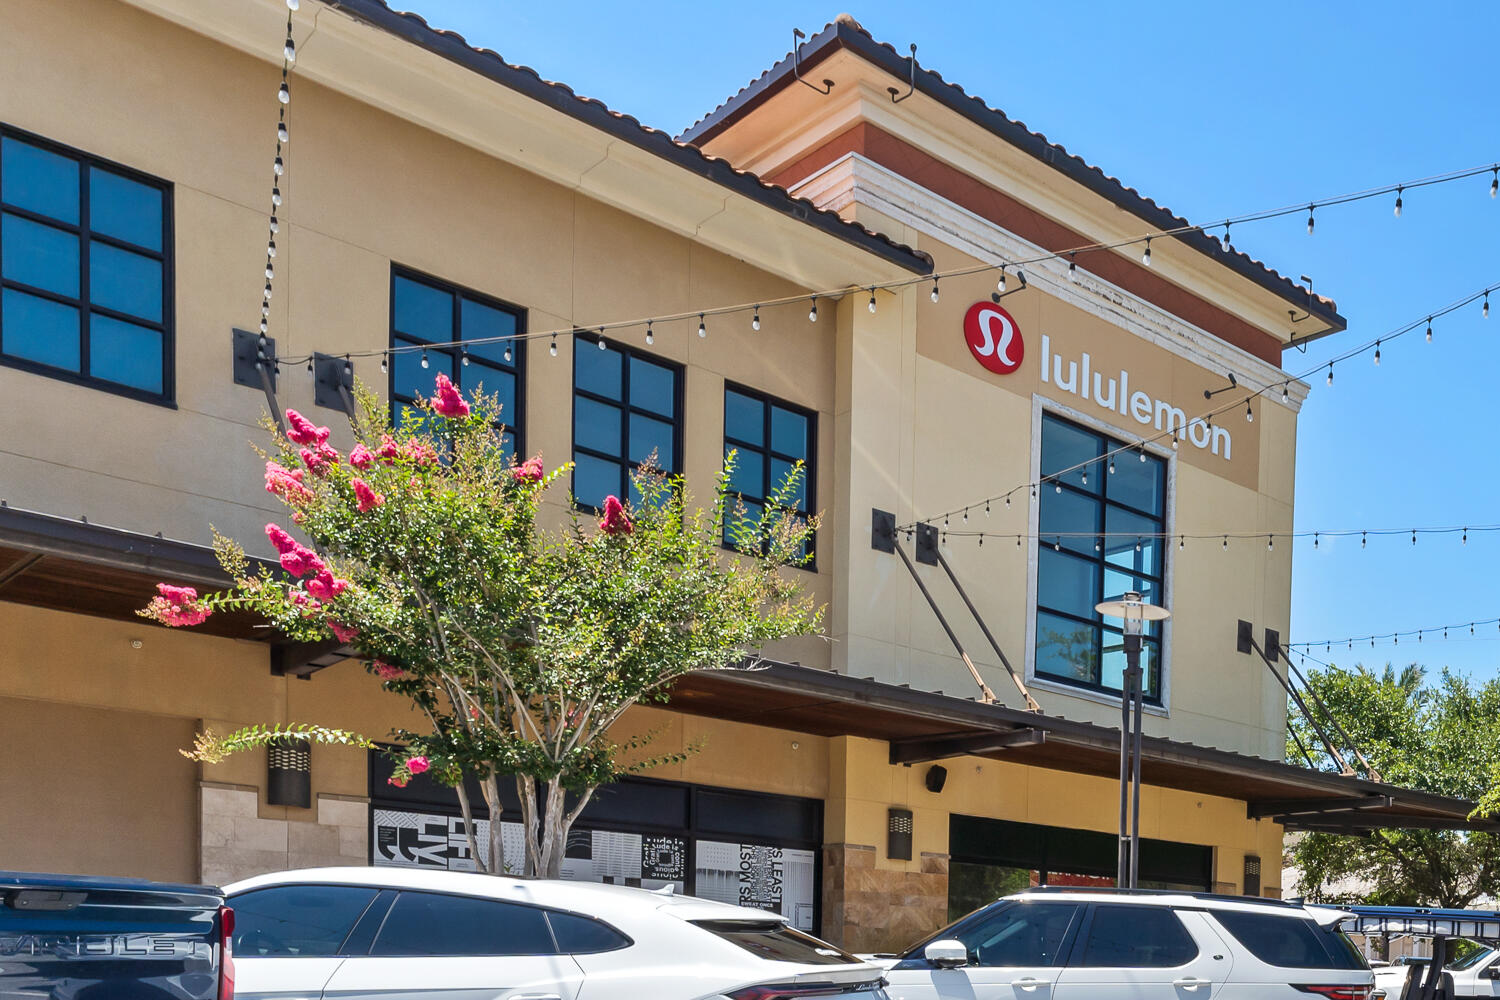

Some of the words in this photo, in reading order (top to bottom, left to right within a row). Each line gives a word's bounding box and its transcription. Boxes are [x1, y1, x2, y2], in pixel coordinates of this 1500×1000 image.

[1040, 334, 1232, 461] lululemon
[739, 843, 752, 883] MOST
[772, 862, 783, 903] LEAST
